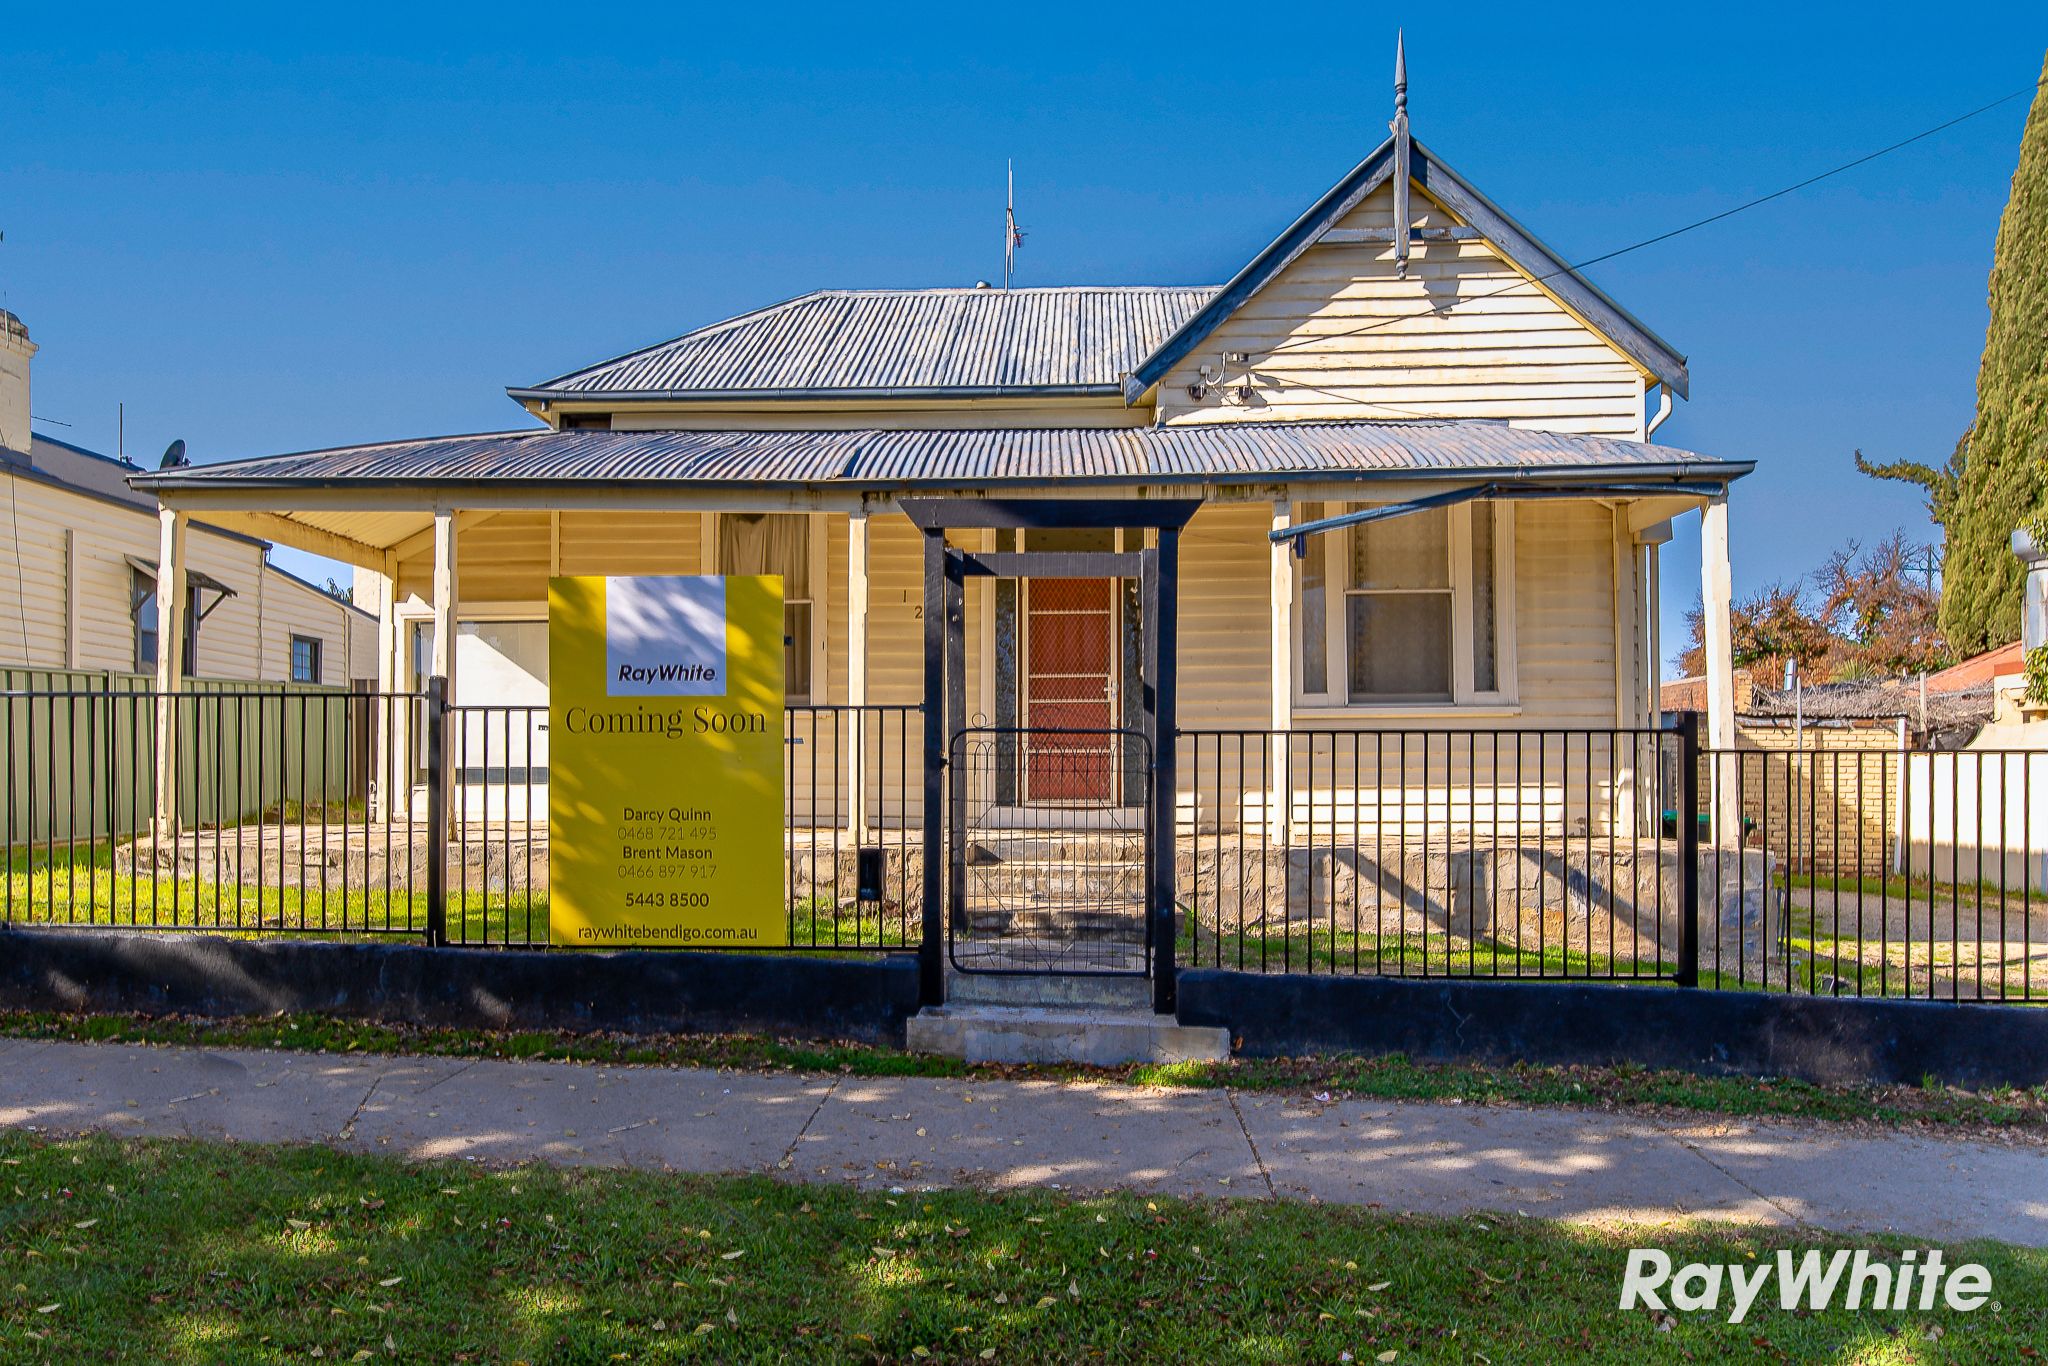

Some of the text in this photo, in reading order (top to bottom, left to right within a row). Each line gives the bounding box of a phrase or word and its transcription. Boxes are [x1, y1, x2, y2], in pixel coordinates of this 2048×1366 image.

[565, 705, 767, 740] Coming Soon
[623, 807, 712, 824] Darcy Quinn
[617, 827, 717, 841] 0468 721 495
[623, 846, 713, 860] Brent Mason
[617, 865, 717, 879] 0466 897 917
[625, 892, 710, 908] 5443 8500
[578, 924, 758, 941] raywhitebendigo.com.au
